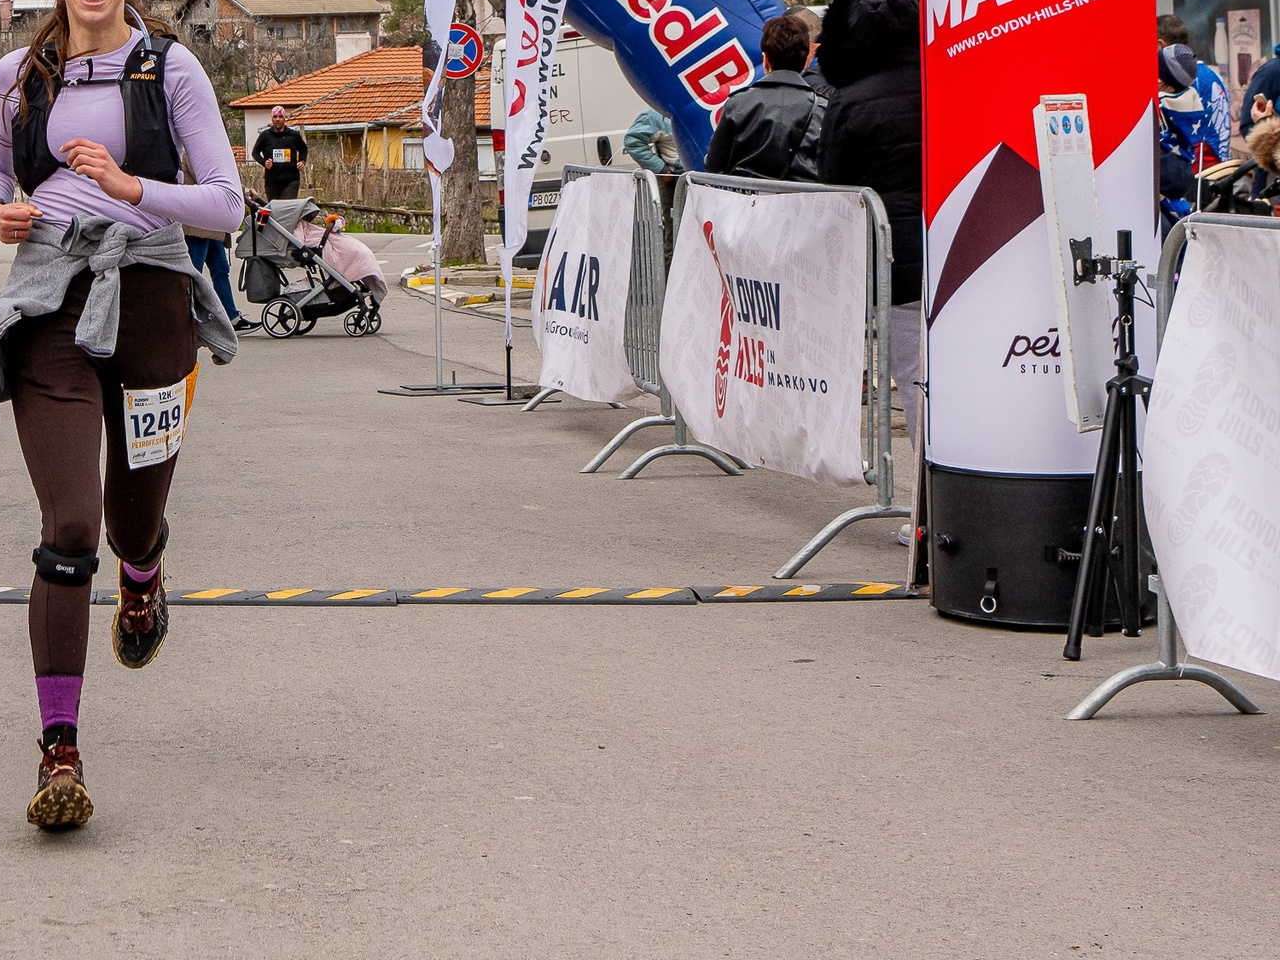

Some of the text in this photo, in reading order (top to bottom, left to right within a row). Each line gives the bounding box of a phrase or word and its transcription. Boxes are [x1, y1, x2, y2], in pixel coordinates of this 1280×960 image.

[767, 349, 776, 364] IN
[1020, 364, 1061, 374] STUD
[130, 404, 181, 439] 1249
